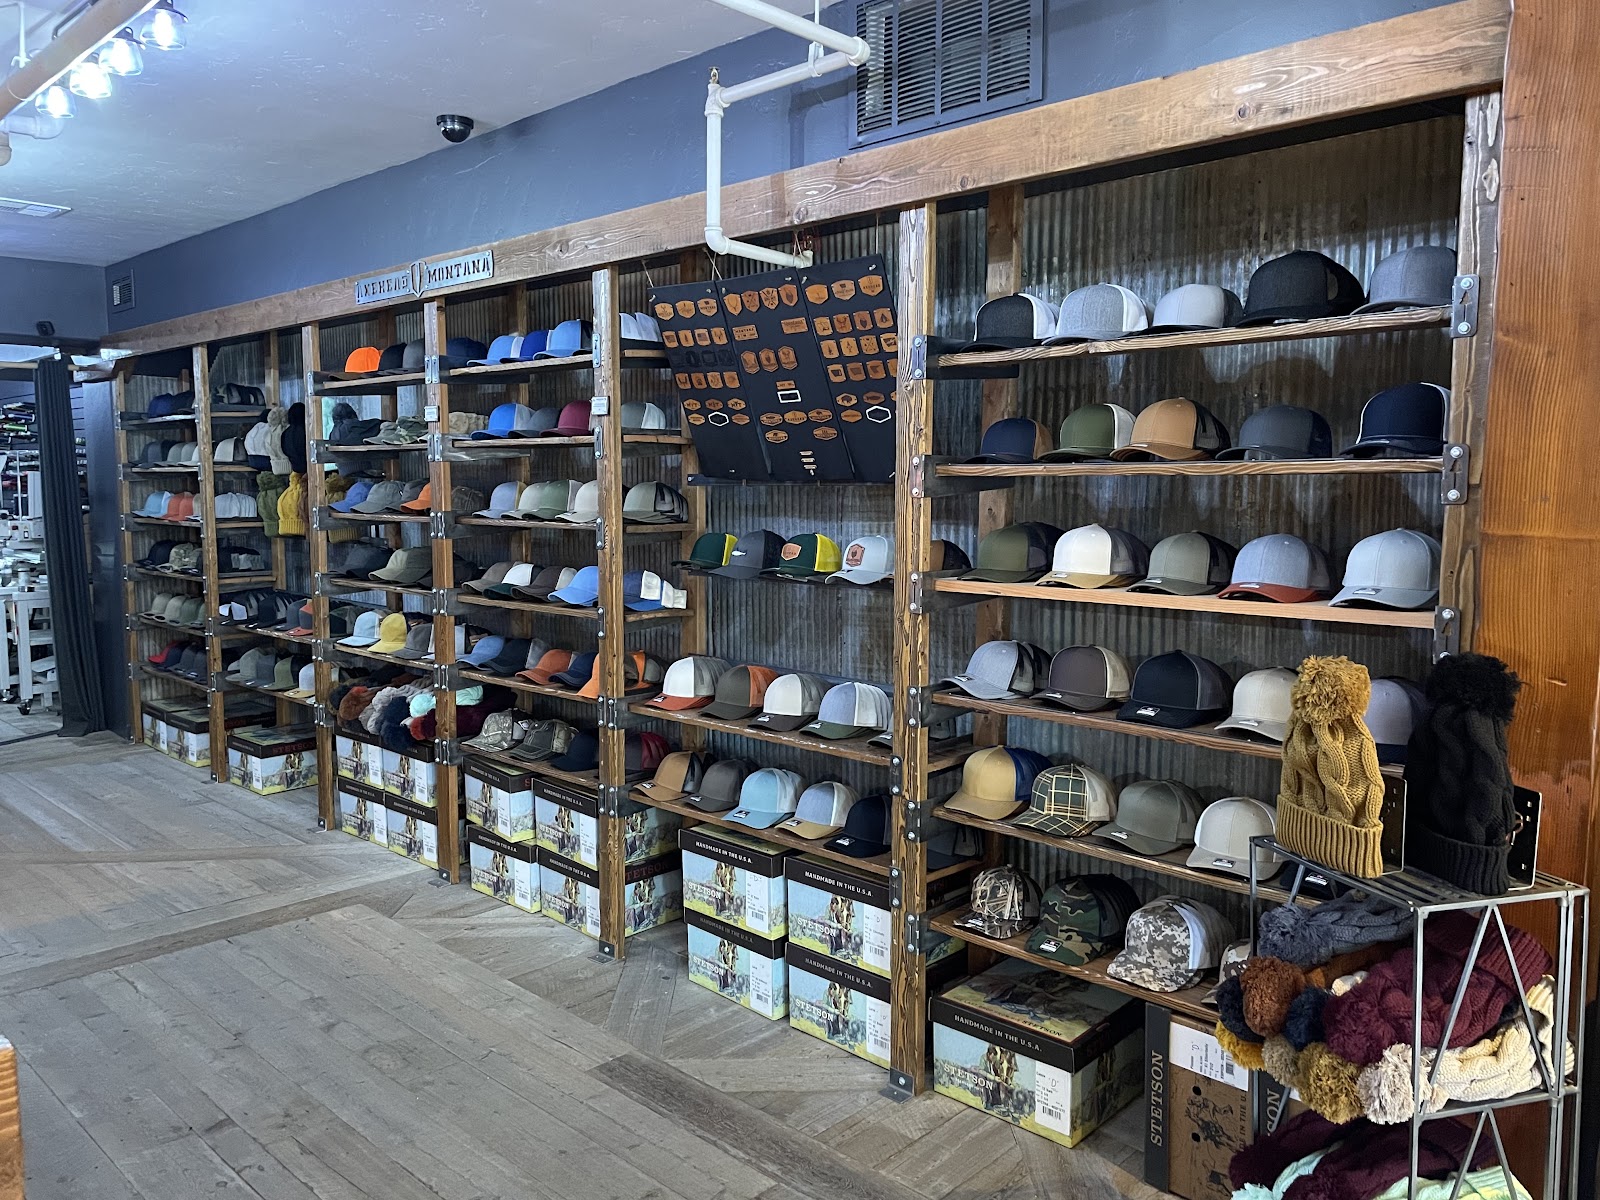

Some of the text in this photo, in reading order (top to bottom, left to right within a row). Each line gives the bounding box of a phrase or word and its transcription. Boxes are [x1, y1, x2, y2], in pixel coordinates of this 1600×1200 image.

[357, 257, 491, 299] AXEHEAD MONTANA
[695, 841, 721, 854] HANDMADE
[728, 851, 738, 859] THE
[688, 882, 721, 900] STETSON
[805, 871, 835, 885] HANDMADE
[844, 883, 855, 891] THE
[797, 917, 836, 938] STETSON
[693, 955, 724, 976] STETSON
[805, 958, 835, 974] HANDMADE
[836, 969, 843, 977] IN
[844, 972, 855, 981] THE
[795, 998, 834, 1022] STETSON
[954, 1014, 1043, 1052] HANDMADE IN THE U.S.A.
[1021, 1020, 1062, 1037] STETSON
[943, 1063, 994, 1090] STETSON
[1150, 1050, 1163, 1146] STETSON
[1239, 1103, 1247, 1122] THE
